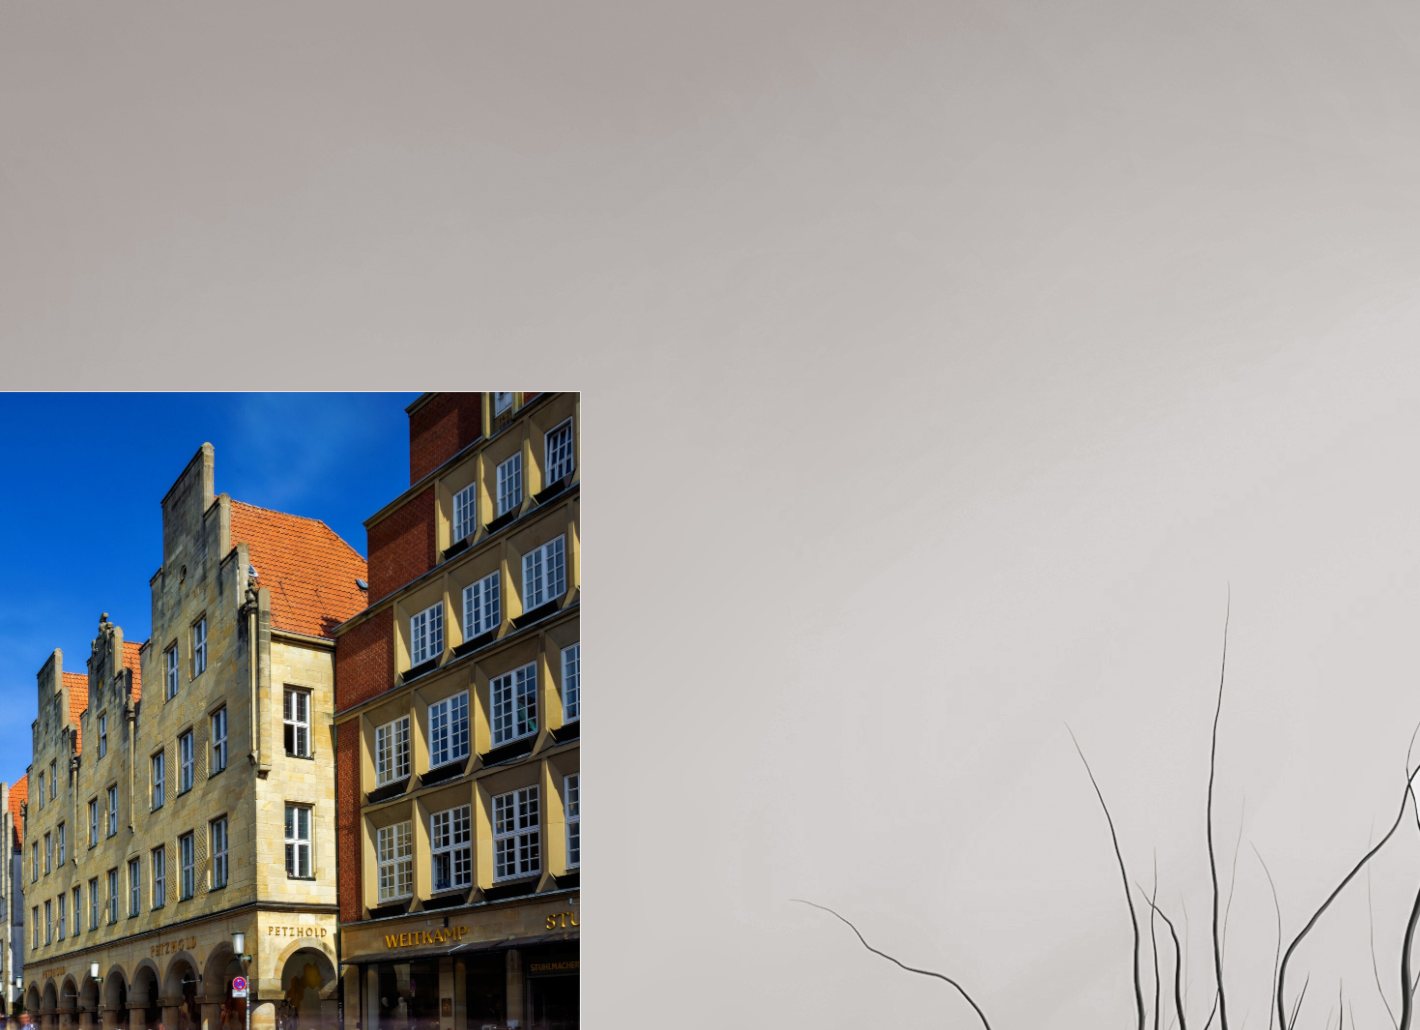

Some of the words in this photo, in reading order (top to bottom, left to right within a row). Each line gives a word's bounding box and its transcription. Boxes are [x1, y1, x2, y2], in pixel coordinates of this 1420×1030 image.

[268, 926, 328, 938] PETZHOLD
[385, 925, 468, 949] WEITKAMP
[150, 936, 197, 957] PETZHOLD
